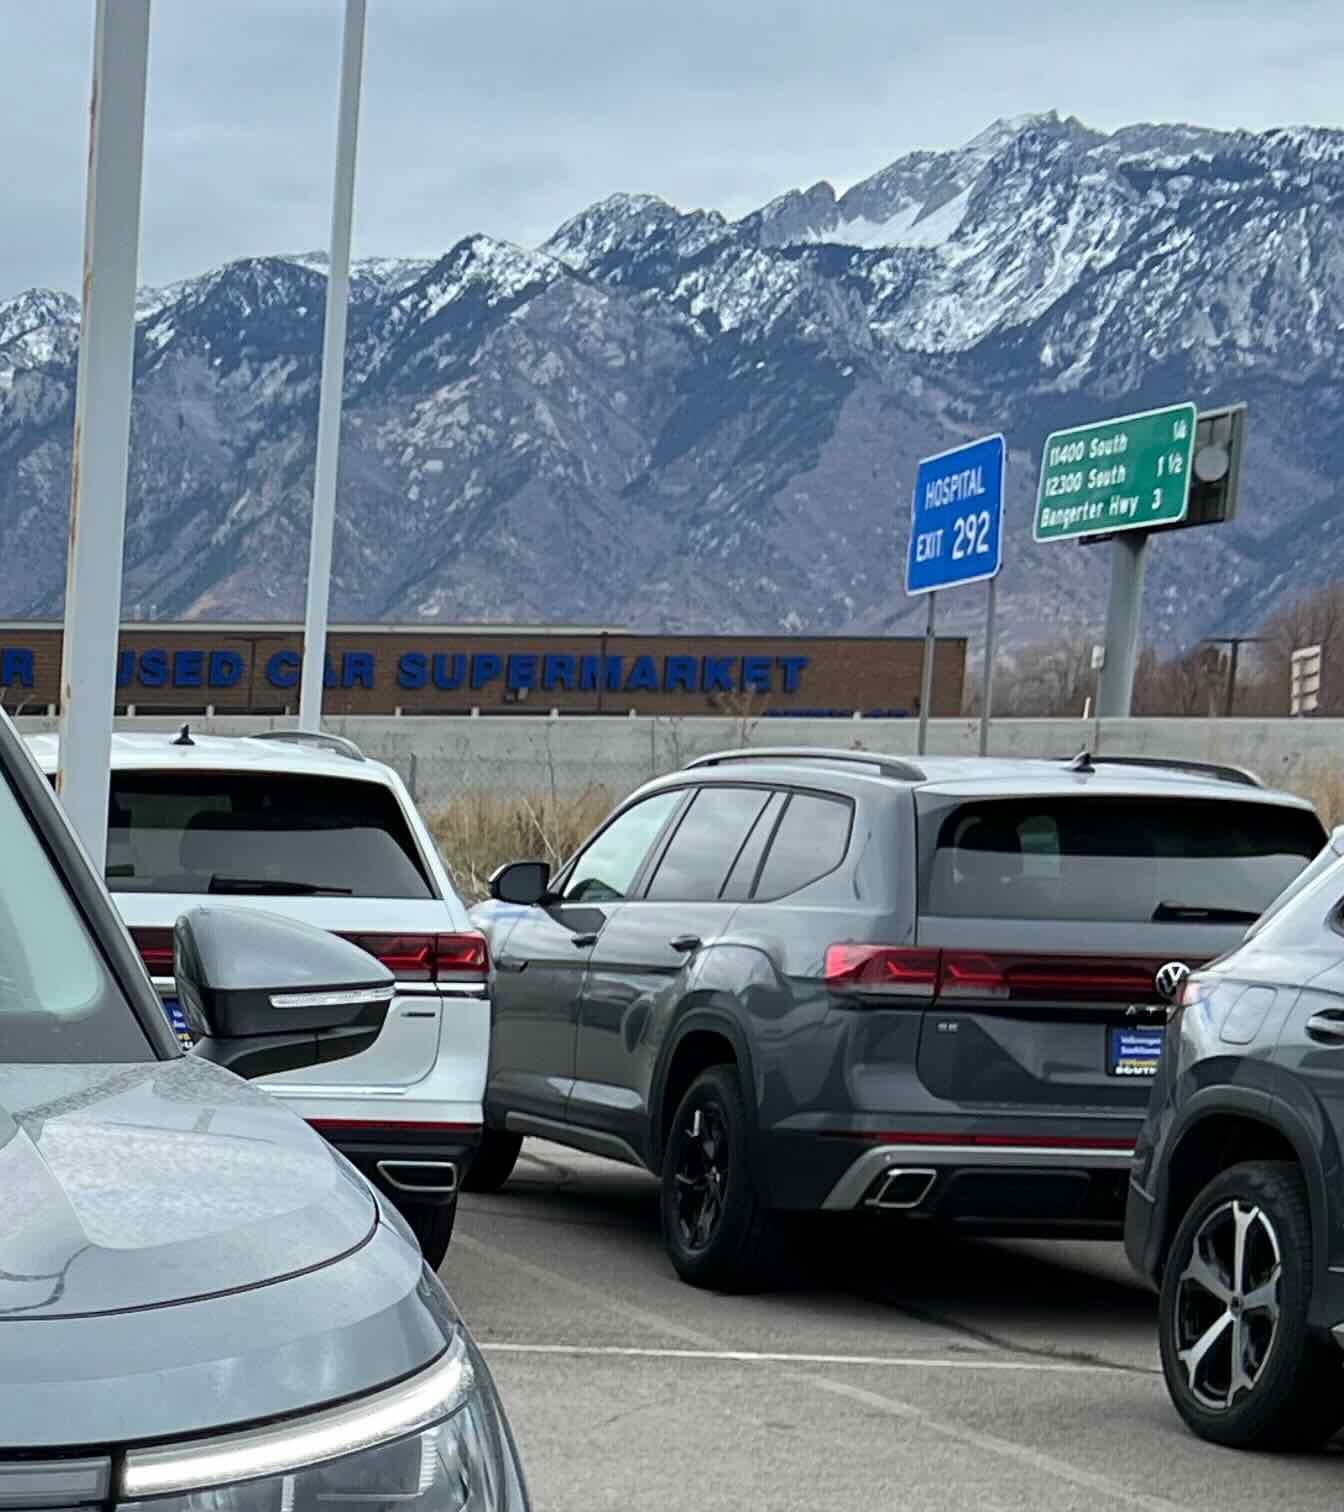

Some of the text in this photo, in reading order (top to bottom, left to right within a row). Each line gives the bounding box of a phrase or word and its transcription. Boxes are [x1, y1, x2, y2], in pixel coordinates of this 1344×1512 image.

[1089, 432, 1128, 459] South
[924, 464, 987, 511] HOSPITAL
[1088, 464, 1126, 489] South
[1040, 487, 1163, 530] Bangerter Hwy 3
[916, 510, 991, 563] EXIT 292
[265, 650, 376, 689] CR
[396, 653, 811, 692] SUPERMARKET
